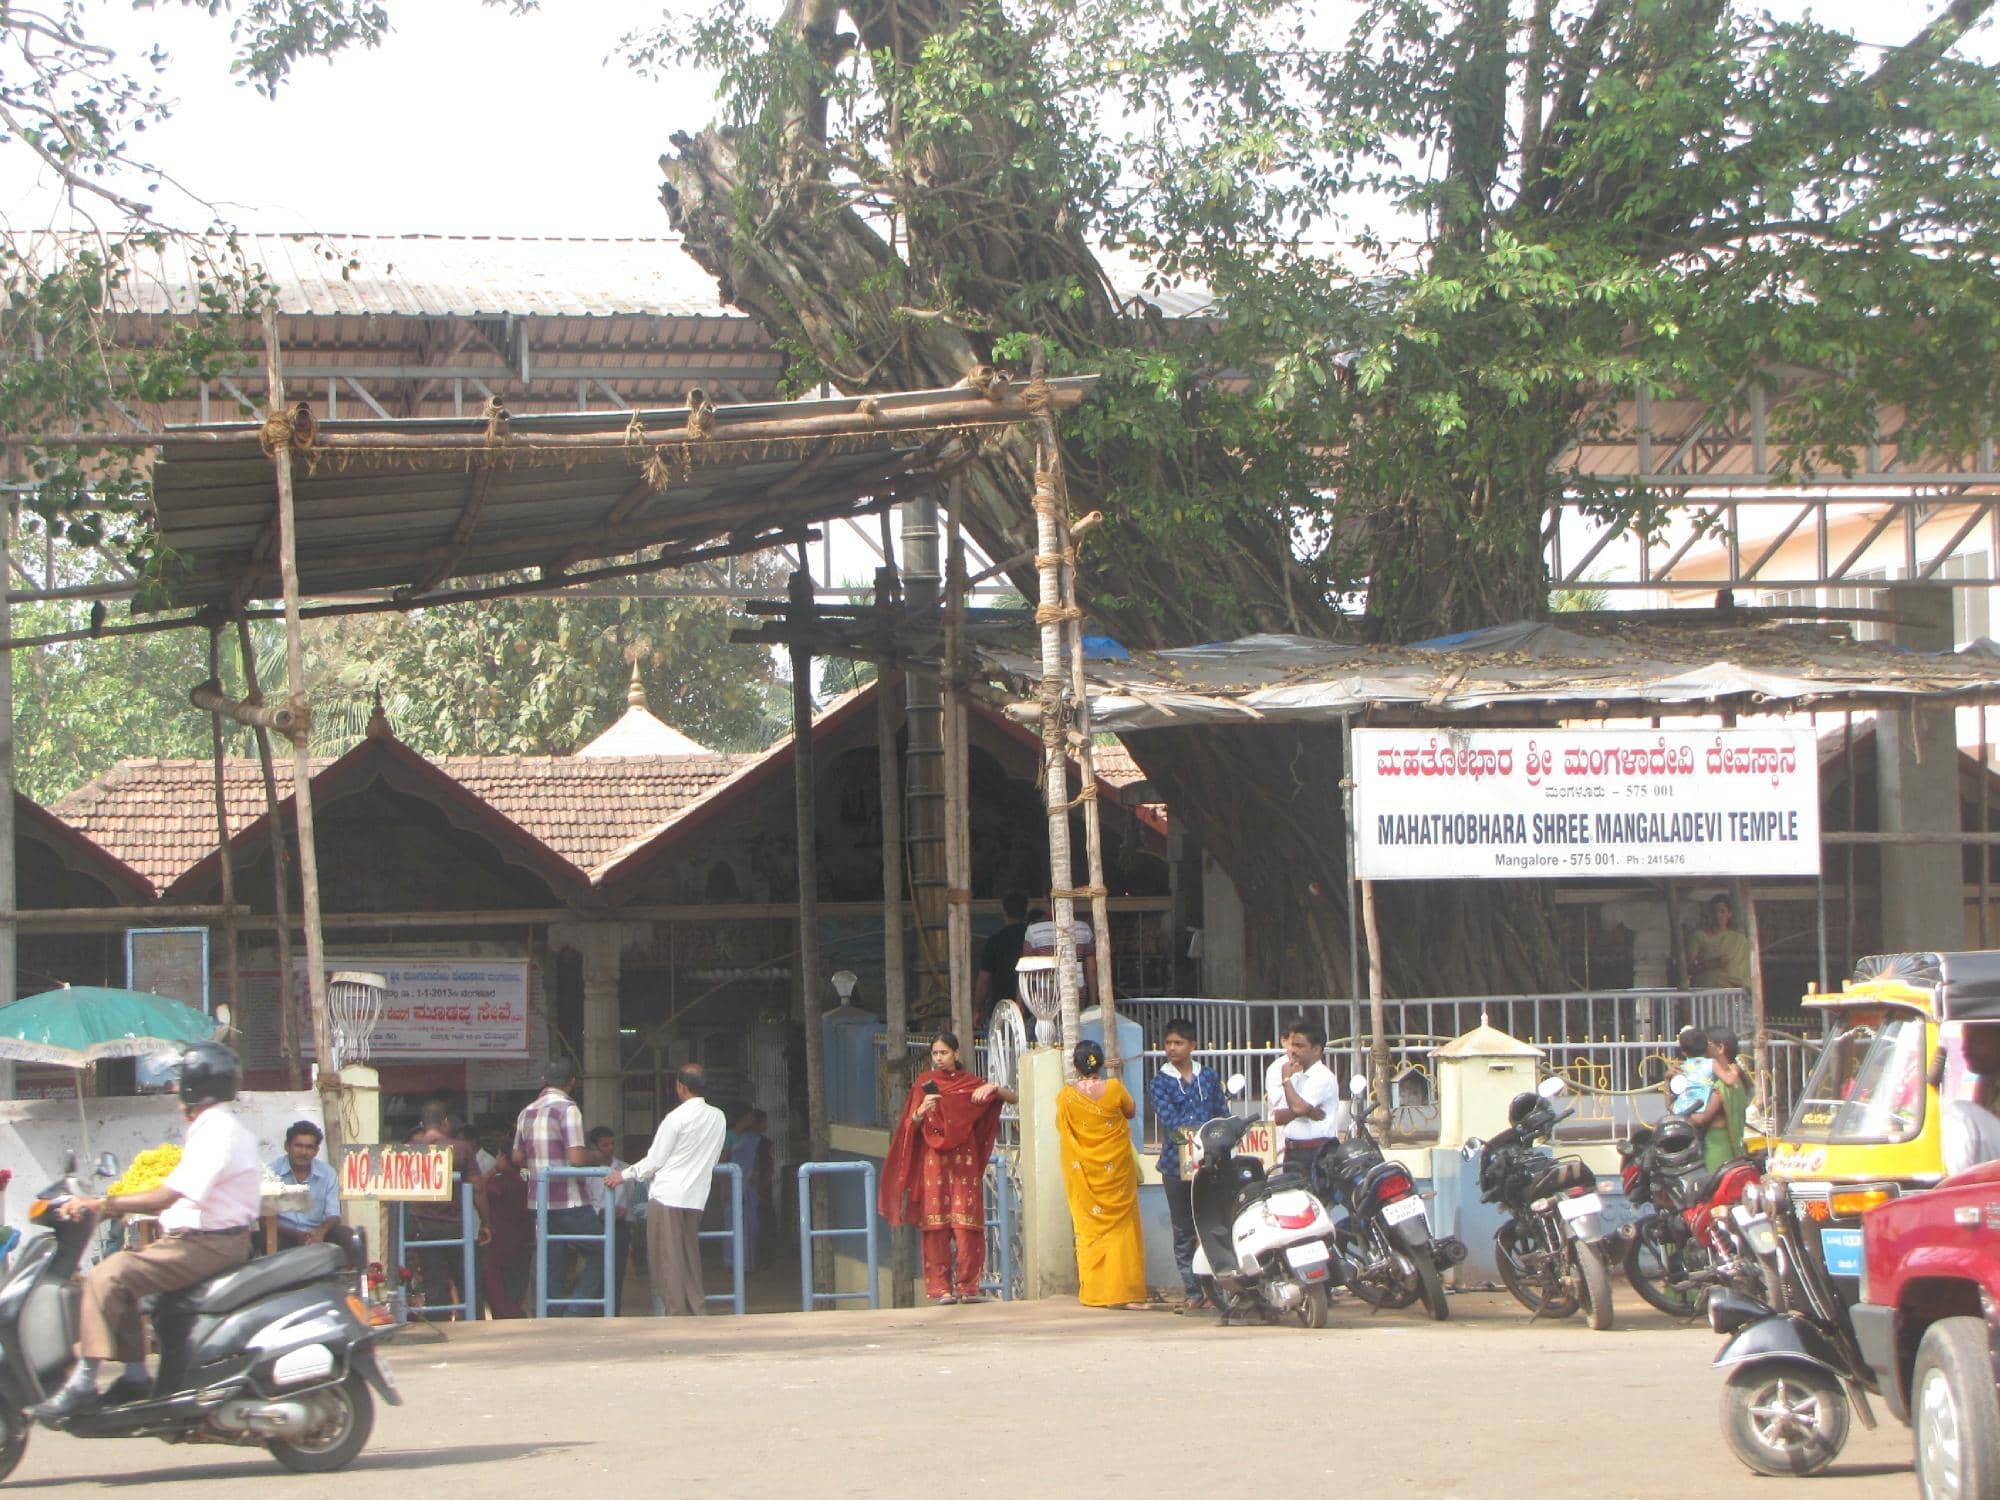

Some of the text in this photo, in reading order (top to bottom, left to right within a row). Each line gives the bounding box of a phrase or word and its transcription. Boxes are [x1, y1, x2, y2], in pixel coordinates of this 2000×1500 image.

[1525, 740, 1552, 786] ಶ್ರೀ
[1564, 736, 1694, 776] ಮಂಗಳಾದೇವಿ
[1706, 736, 1796, 789] ದೇವಸ್ಥಾನ
[1626, 785, 1648, 797] 575
[1654, 784, 1674, 797] 001
[1378, 810, 1798, 845] MAHATHOBHARA SHREE MANGALADEVI TEMPLE
[1495, 853, 1559, 868] Mangalore
[1570, 853, 1591, 866] 575
[1626, 855, 1639, 865] Ph
[1647, 854, 1685, 865] 2415476
[347, 1152, 371, 1191] NO
